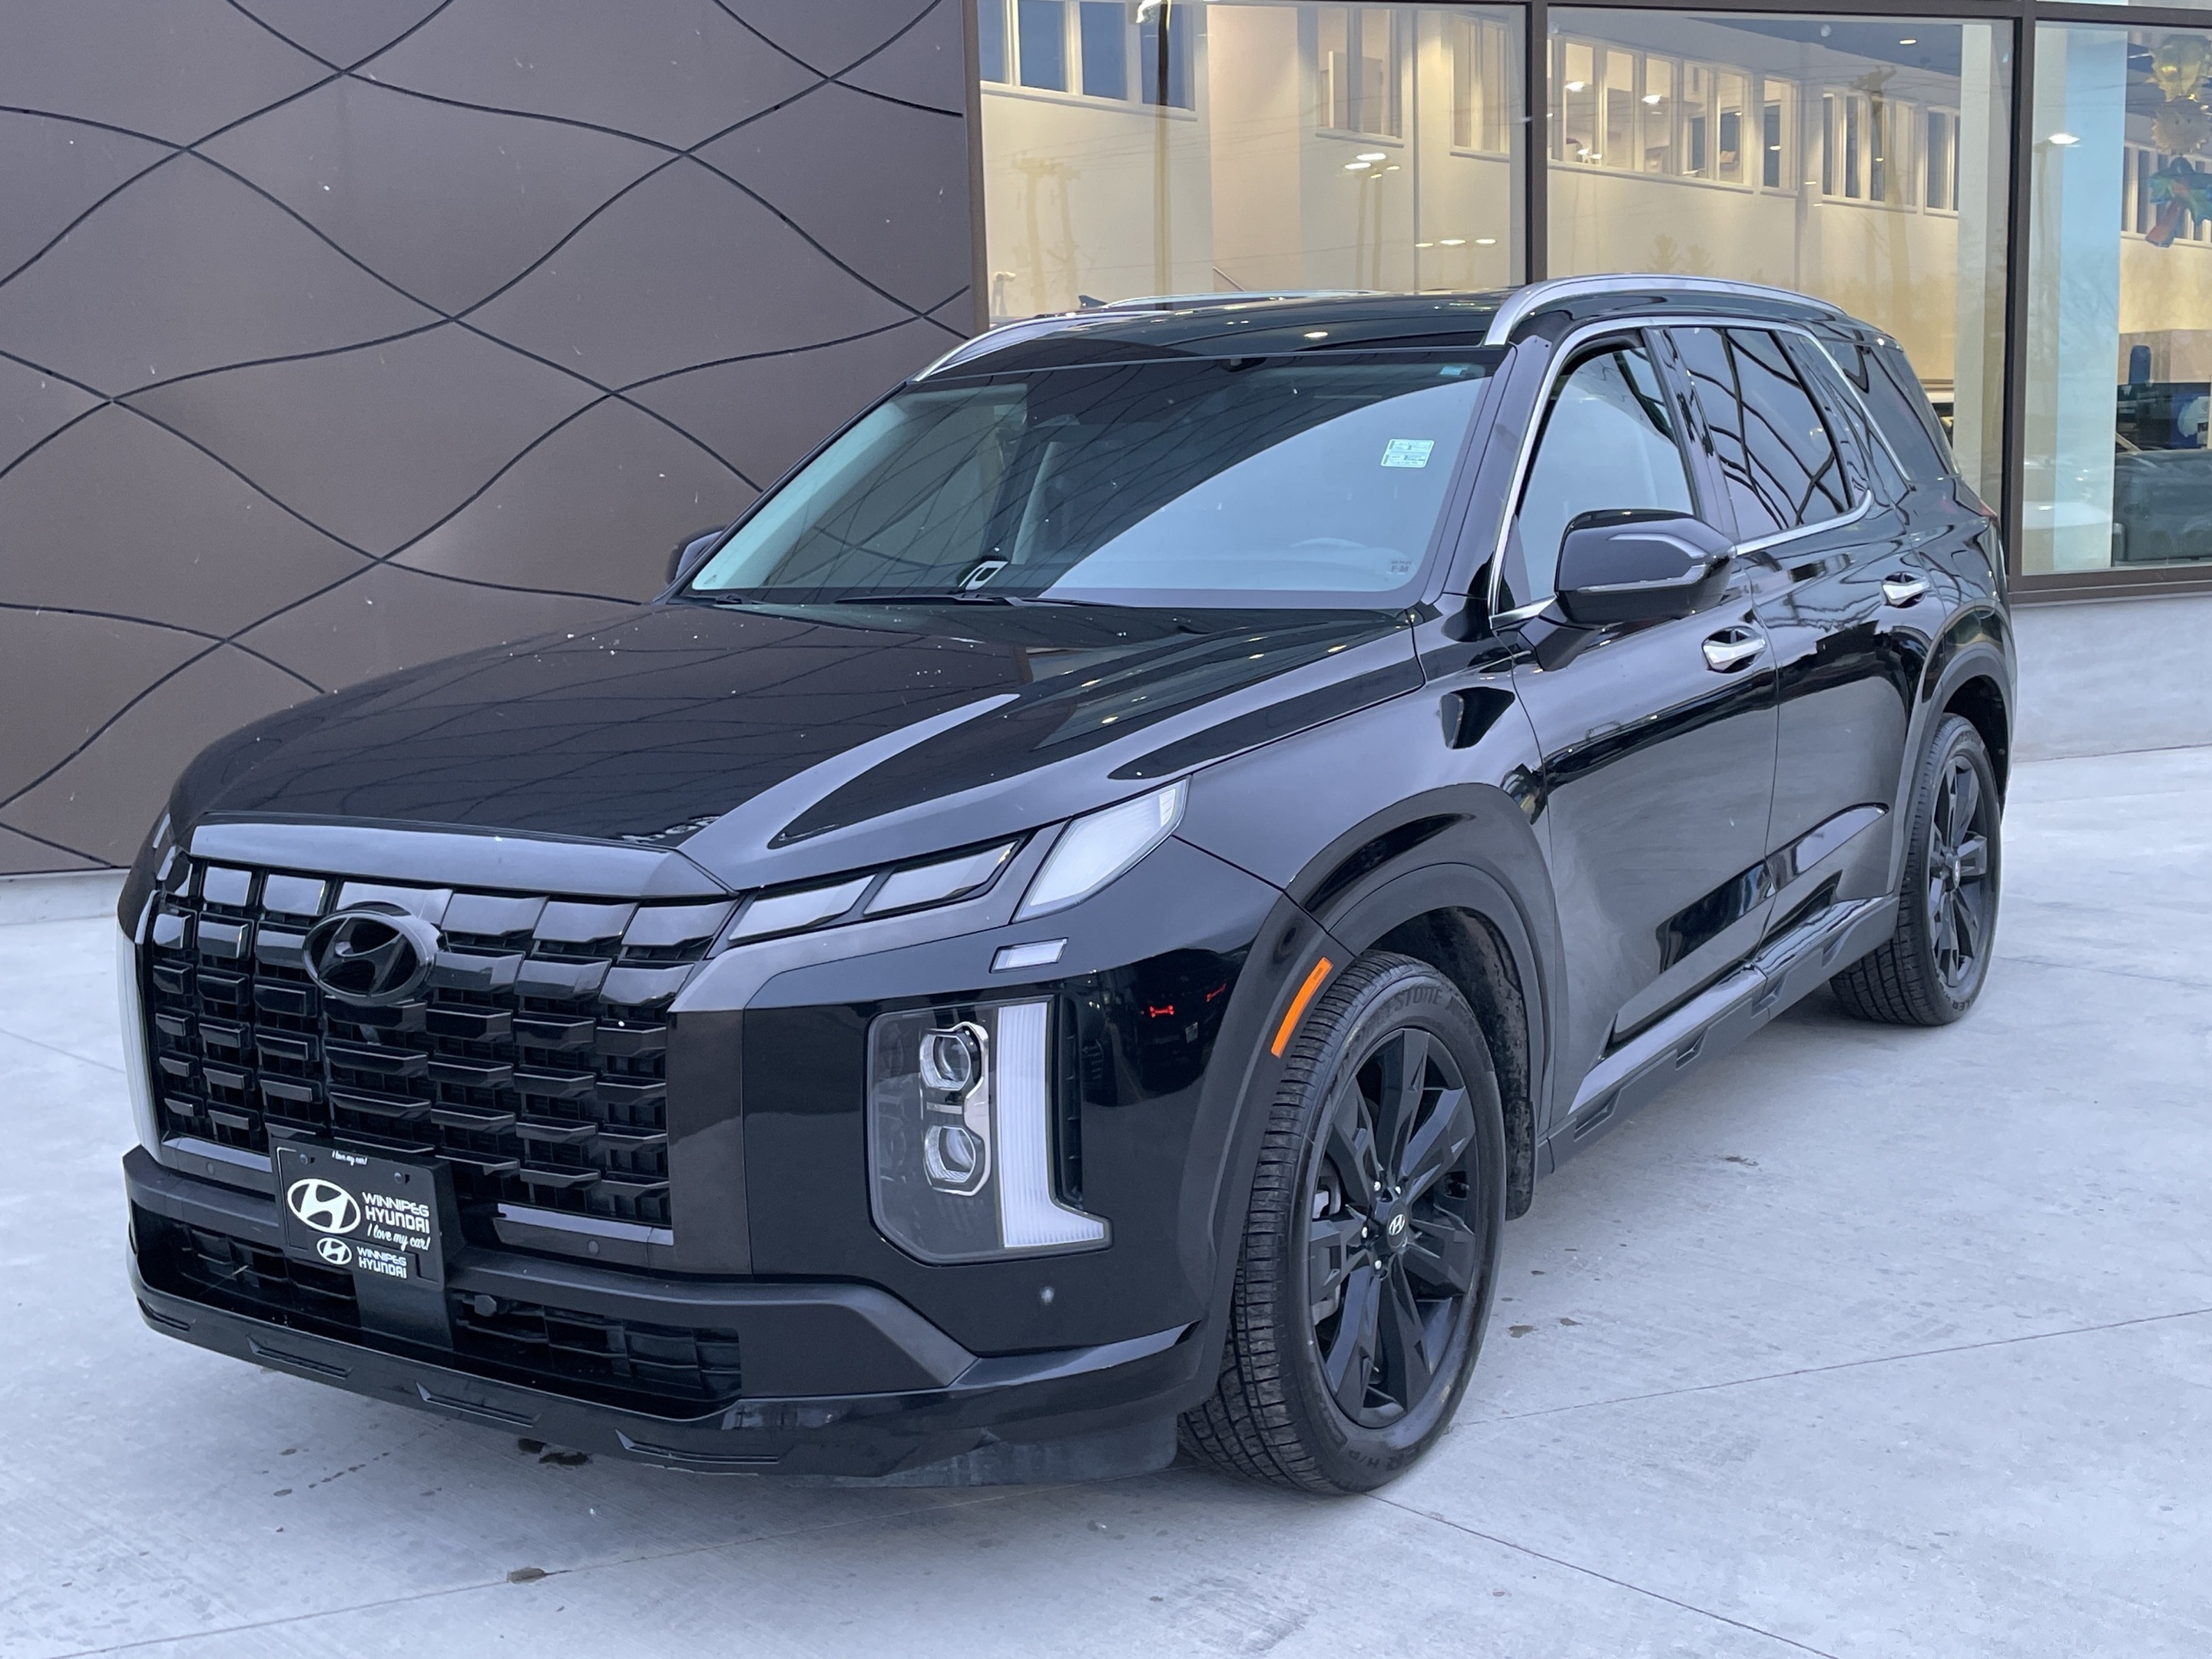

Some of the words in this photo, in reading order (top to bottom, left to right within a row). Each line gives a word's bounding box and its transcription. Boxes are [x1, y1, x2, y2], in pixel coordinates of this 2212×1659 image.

[362, 1191, 429, 1217] WINNIPEG
[365, 1205, 430, 1234] HYUNDAI
[367, 1224, 373, 1237] I
[373, 1224, 392, 1242] love
[393, 1232, 409, 1252] my
[409, 1236, 431, 1251] car!
[356, 1246, 407, 1267] WINNIPEG
[359, 1257, 407, 1279] HYUNDAI
